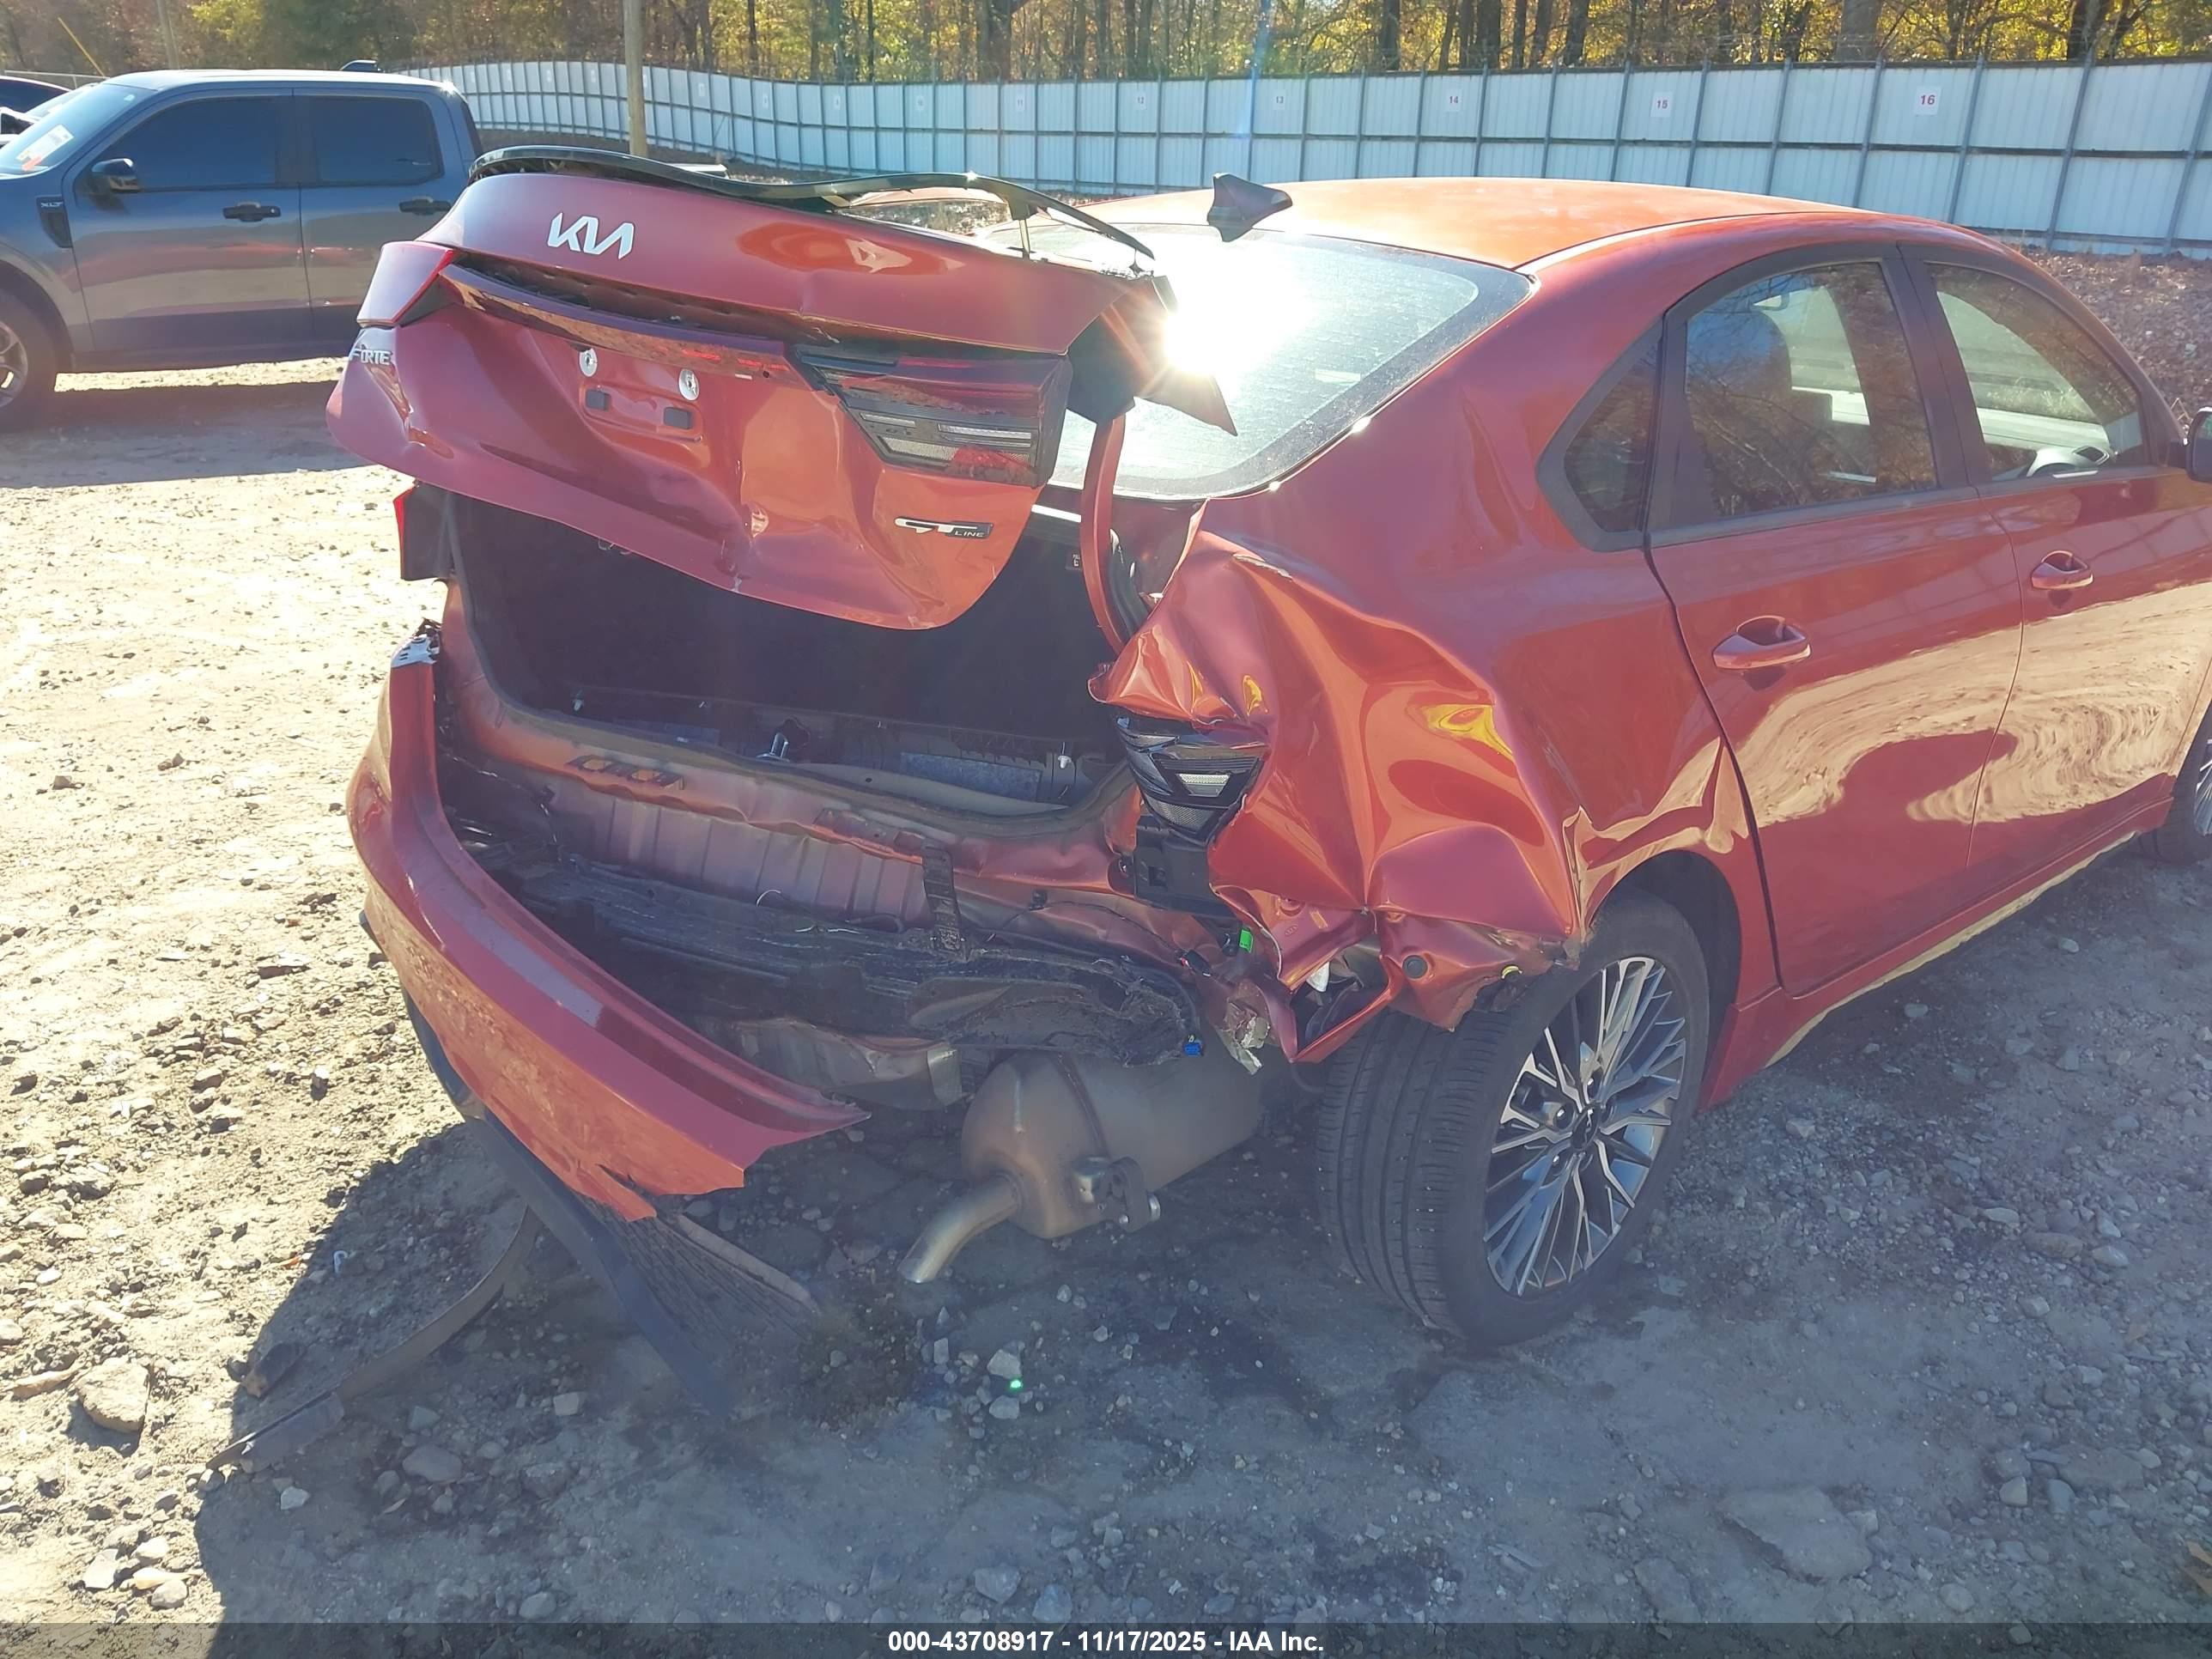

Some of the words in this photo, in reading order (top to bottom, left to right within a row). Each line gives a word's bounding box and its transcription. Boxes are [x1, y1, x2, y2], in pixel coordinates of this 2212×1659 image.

[1449, 95, 1459, 104] 14
[1656, 100, 1668, 109] 15
[1920, 94, 1936, 105] 16
[547, 211, 635, 259] KIA
